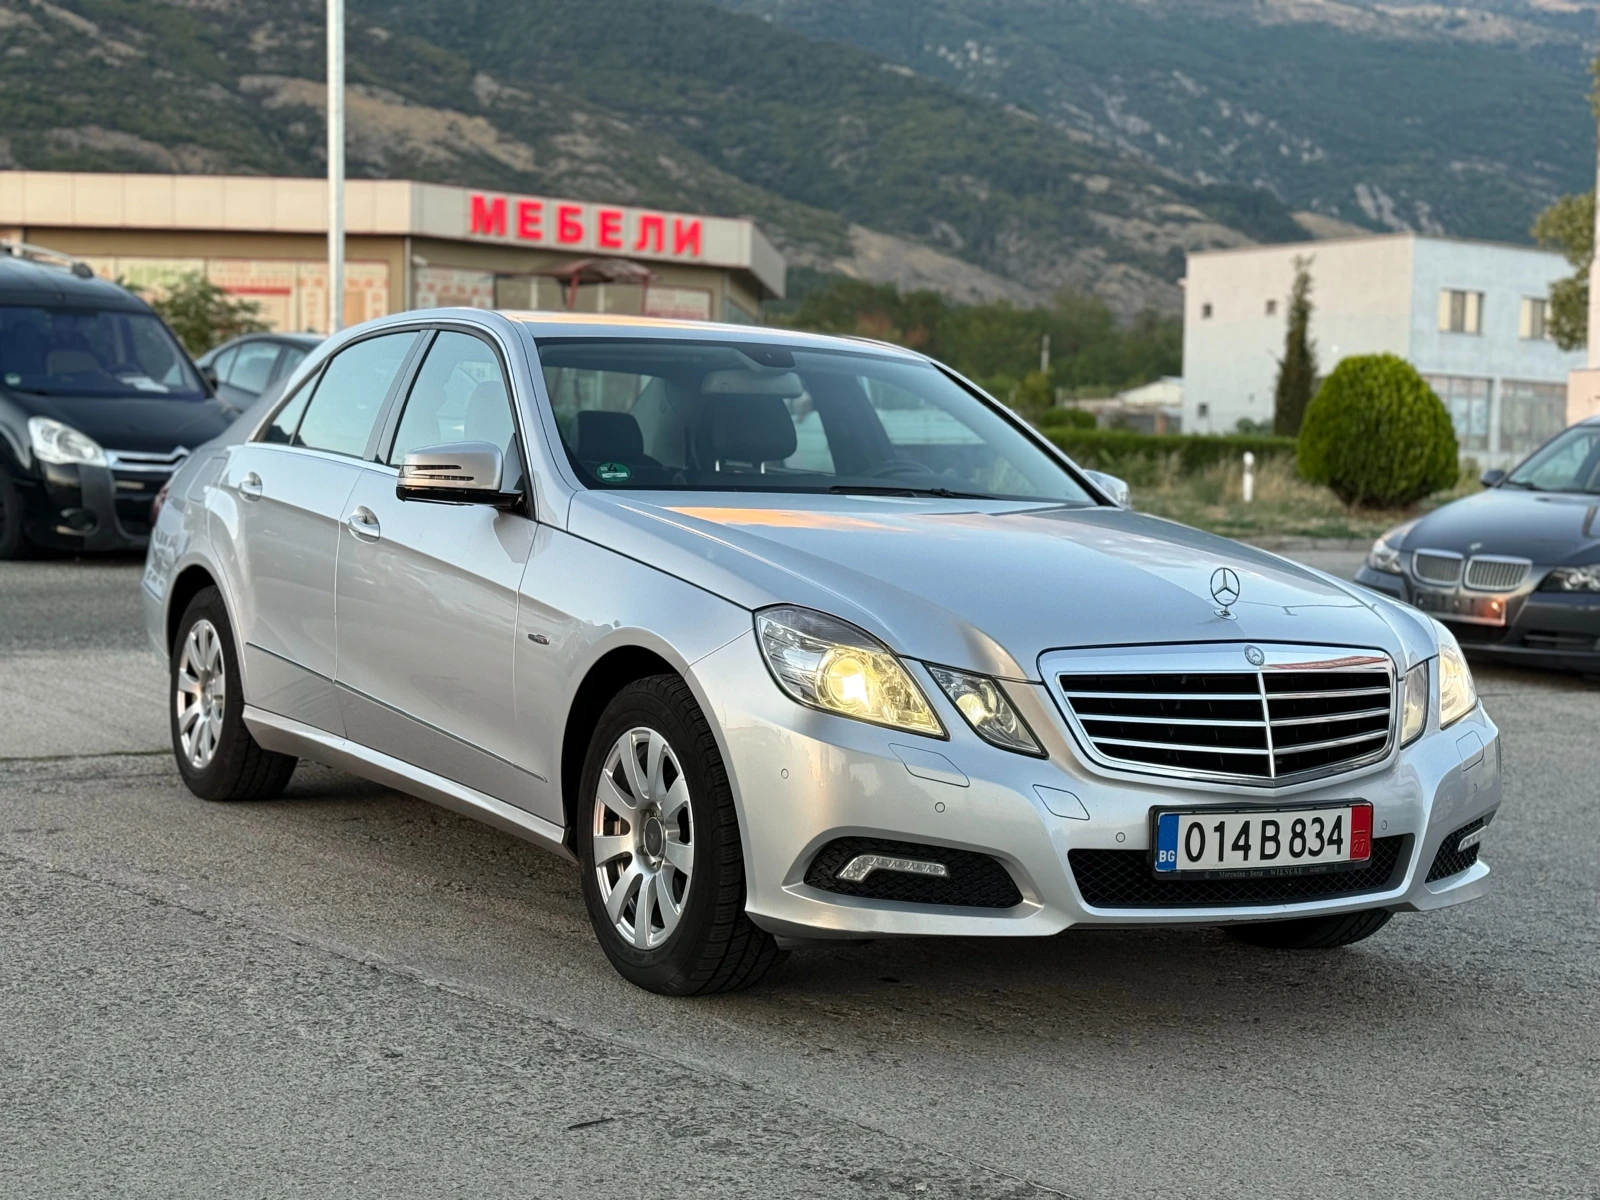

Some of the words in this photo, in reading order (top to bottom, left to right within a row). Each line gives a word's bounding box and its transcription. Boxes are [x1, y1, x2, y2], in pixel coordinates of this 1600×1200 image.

[470, 193, 702, 257] МЕБЕЛИ
[1159, 850, 1175, 863] BG
[1184, 815, 1343, 862] 014B834
